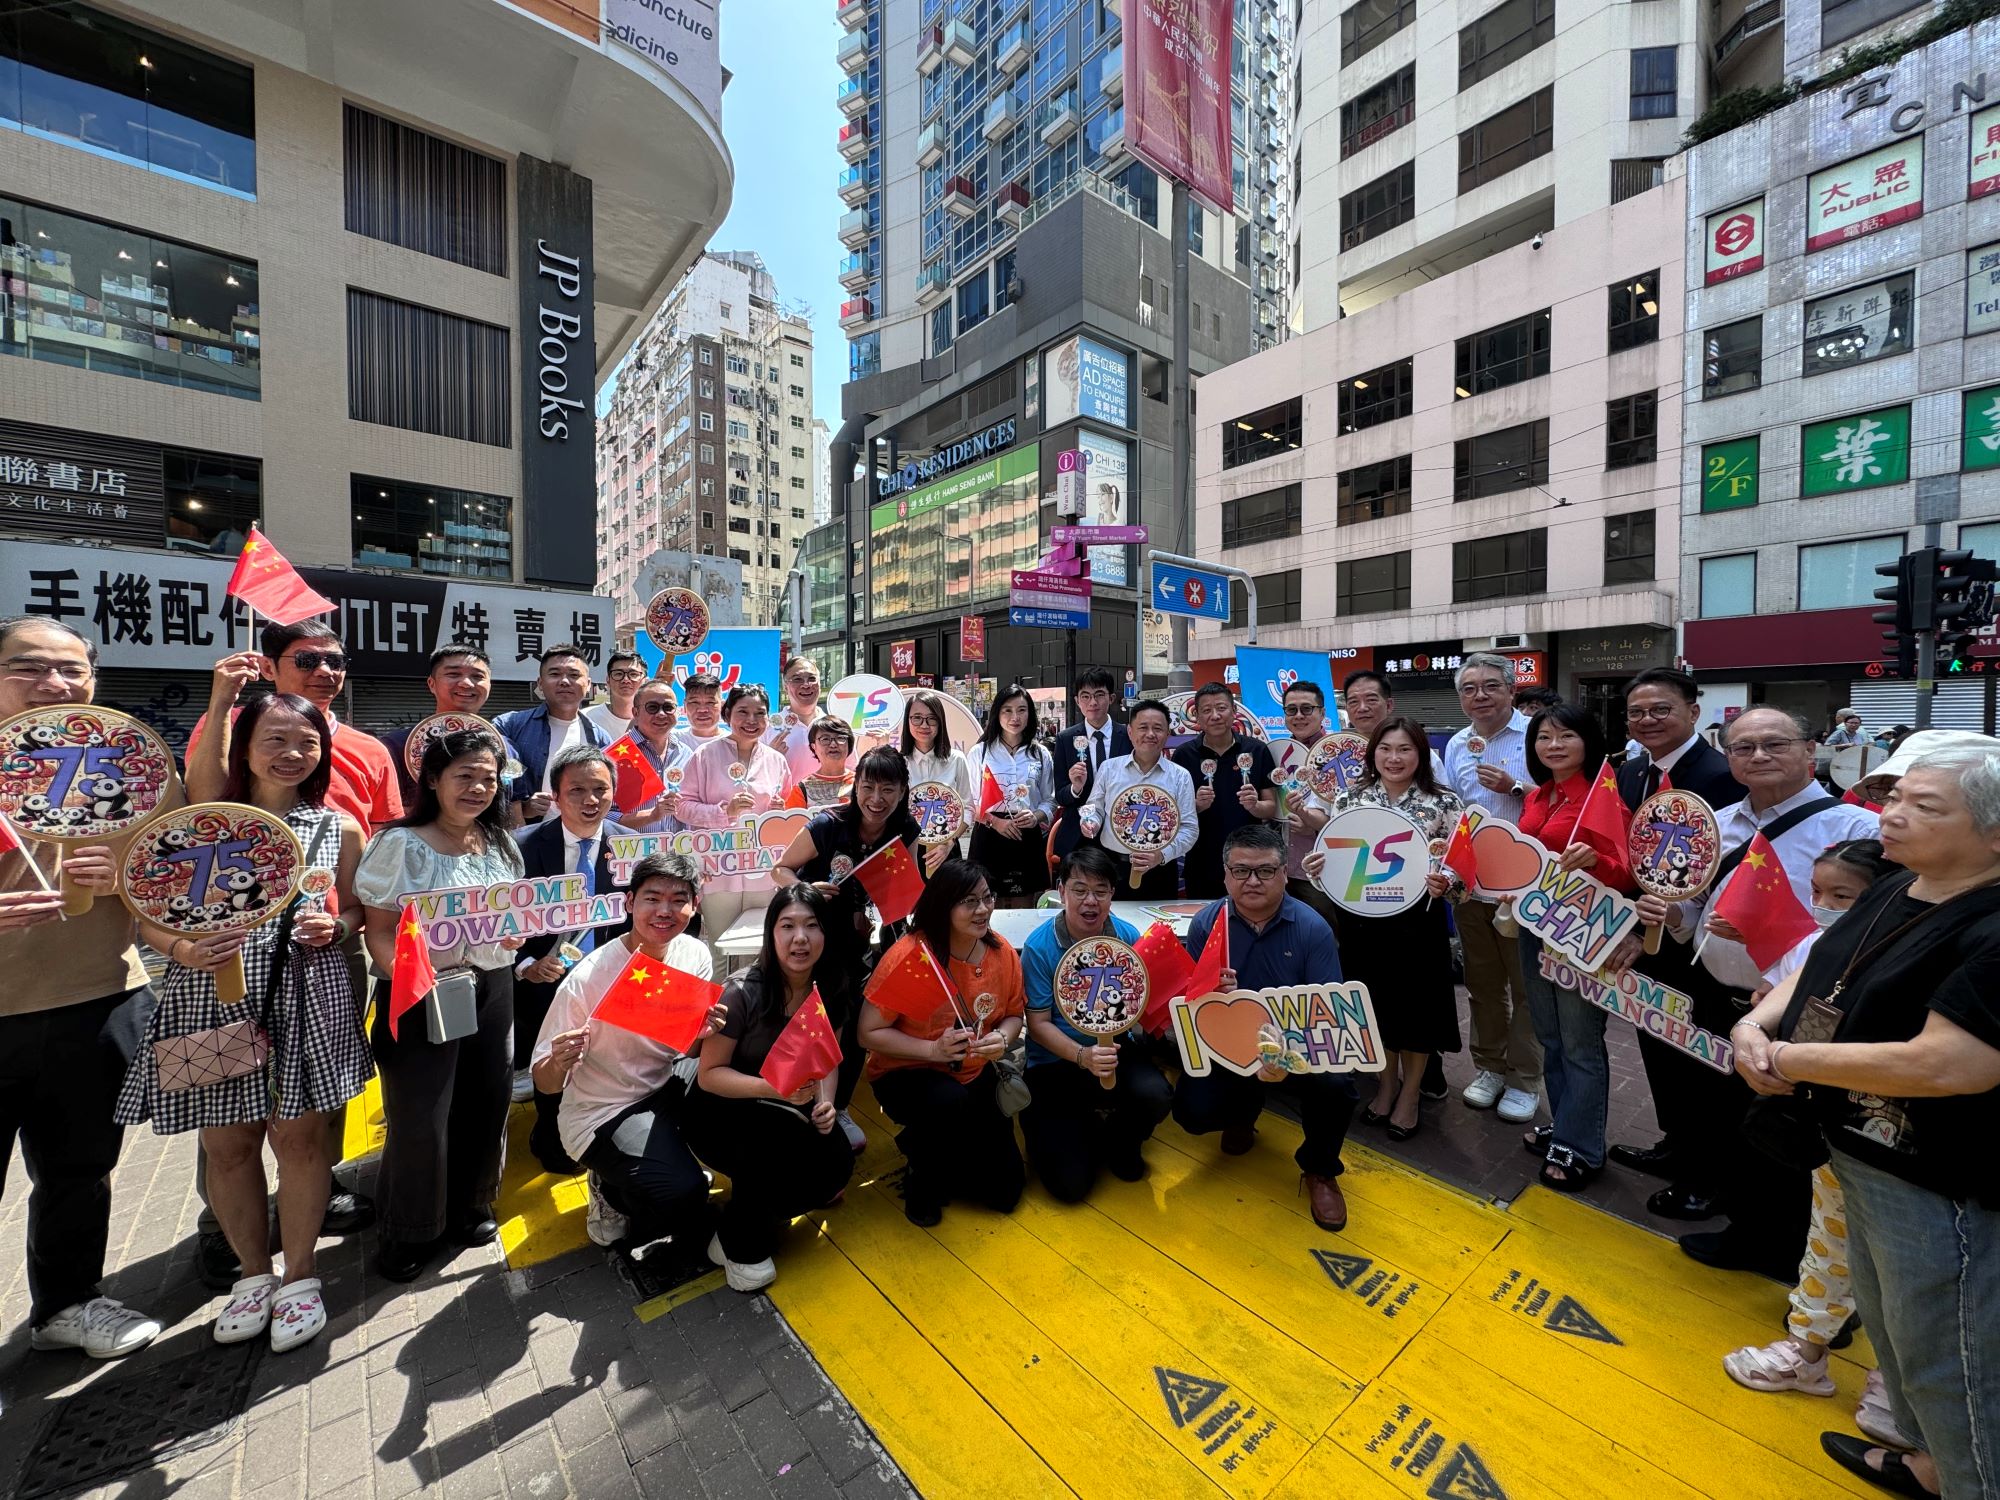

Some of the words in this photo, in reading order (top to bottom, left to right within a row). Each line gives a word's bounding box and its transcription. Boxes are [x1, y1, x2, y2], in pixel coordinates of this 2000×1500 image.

[1823, 181, 1910, 218] PUBLIC
[537, 238, 580, 298] JP
[1723, 263, 1744, 276] 4/F
[539, 302, 586, 440] Books
[1083, 367, 1101, 385] AD
[1103, 373, 1126, 388] SPACE
[1083, 384, 1093, 395] TO
[1095, 390, 1126, 407] ENQUIRE
[879, 471, 901, 496] CHI
[920, 418, 1016, 479] RESIDENCES
[1096, 454, 1110, 466] CHI
[1112, 460, 1126, 471] 138
[1820, 419, 1891, 483] 葉
[942, 486, 958, 498] HANG
[960, 478, 976, 492] SENG
[977, 470, 995, 484] BANK
[318, 597, 428, 653] UTLET
[452, 601, 601, 667] 特賣場
[665, 607, 695, 636] 75
[1156, 634, 1170, 646] 138
[834, 687, 892, 729] 75
[31, 746, 124, 808] 75
[1321, 748, 1359, 789] 75
[916, 801, 946, 830] 75
[1129, 804, 1160, 835] 75
[611, 831, 752, 859] WELCOME
[1324, 830, 1414, 902] 75
[1650, 822, 1694, 868] 75
[168, 839, 252, 907] 75
[402, 877, 582, 919] WELCOME
[1538, 858, 1632, 937] WAN
[1518, 890, 1609, 966] CHAI
[1080, 966, 1122, 1012] 75
[1265, 994, 1368, 1031] WAN
[1284, 1027, 1378, 1065] CHAI
[1406, 1431, 1446, 1477] CAUTION
